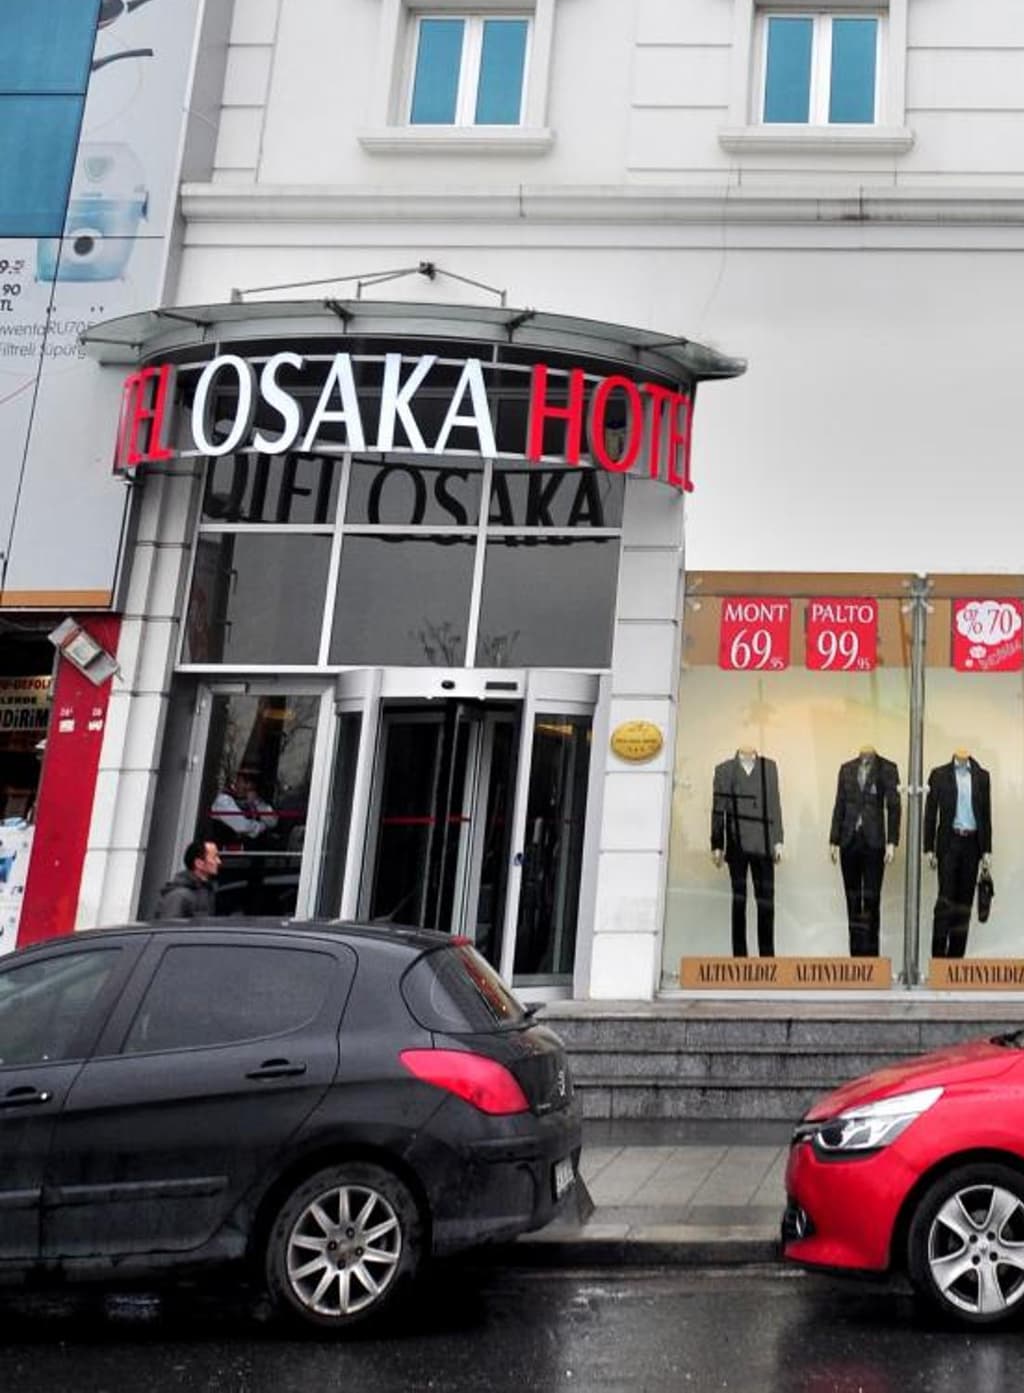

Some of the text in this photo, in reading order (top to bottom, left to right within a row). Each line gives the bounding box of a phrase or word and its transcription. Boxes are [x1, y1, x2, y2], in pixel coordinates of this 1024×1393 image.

[191, 351, 497, 458] OSAKA
[526, 363, 695, 493] HOTEL
[725, 604, 788, 622] MONT
[812, 604, 874, 623] PALTO
[699, 964, 874, 983] ALTINYILDIZ ALTINYILDIZ
